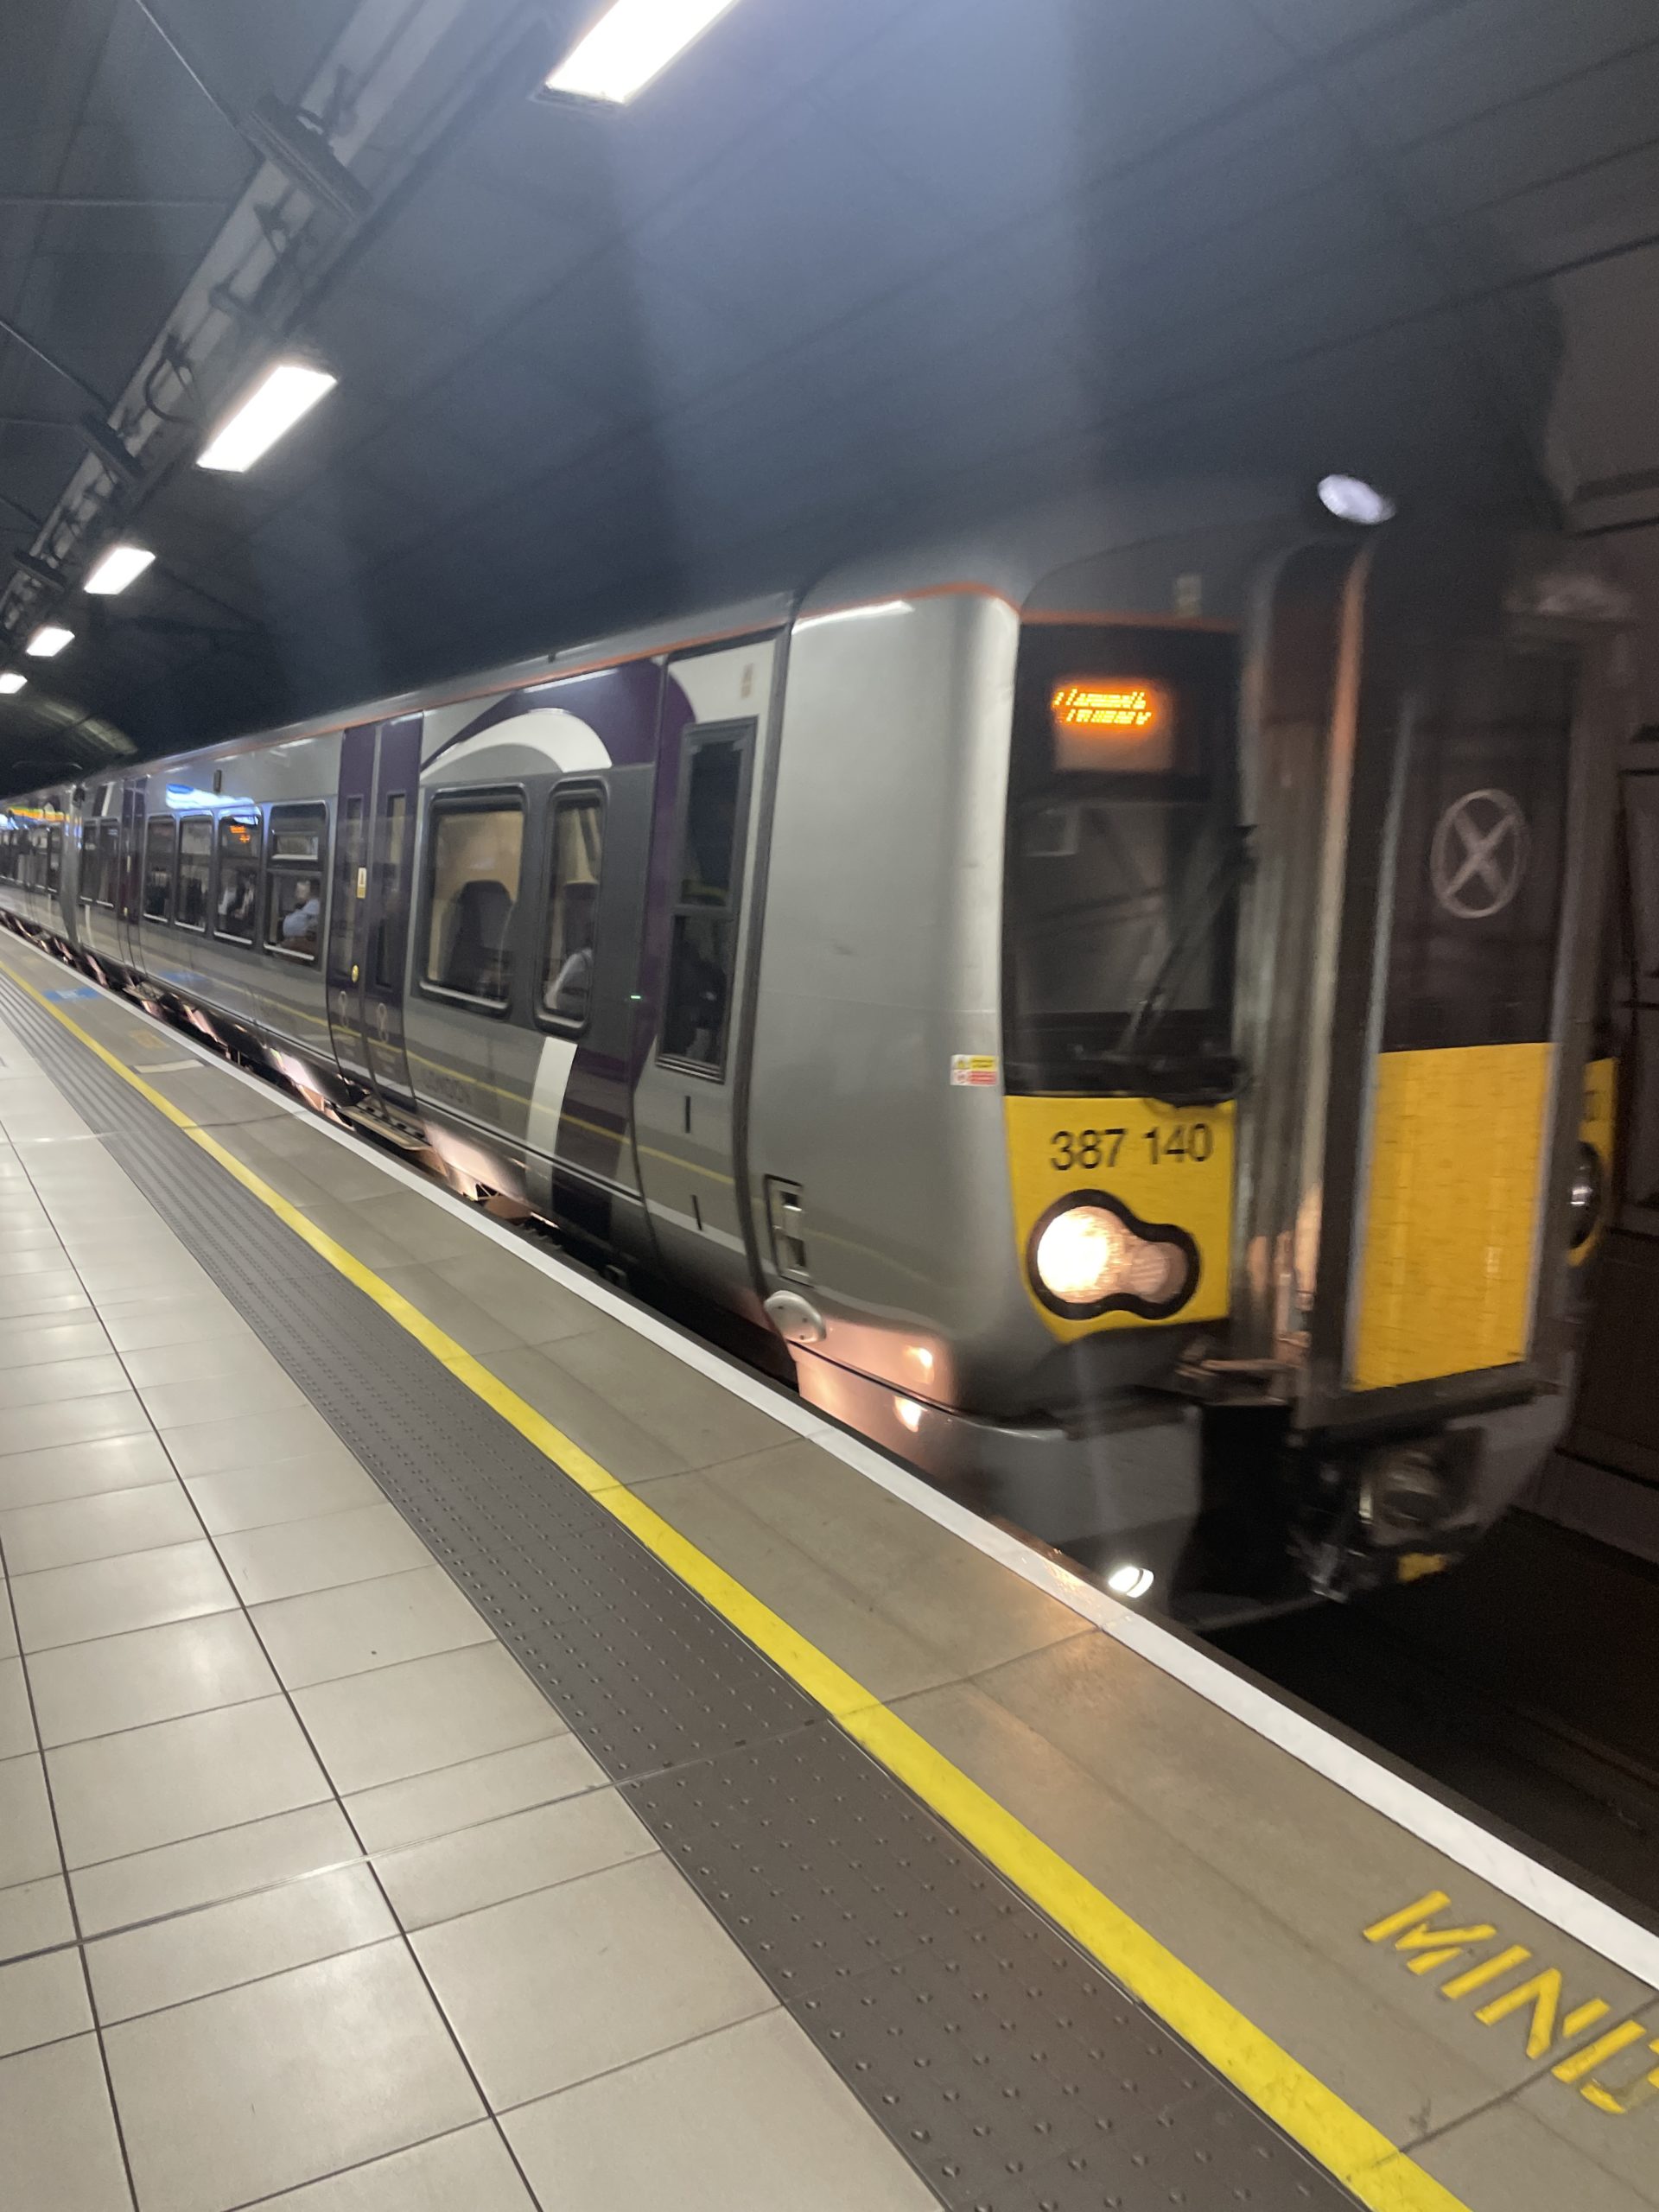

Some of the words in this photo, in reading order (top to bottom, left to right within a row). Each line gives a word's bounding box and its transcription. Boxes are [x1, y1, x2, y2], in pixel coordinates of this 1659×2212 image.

[1050, 1128, 1126, 1171] 387
[1142, 1122, 1214, 1166] 140
[1363, 1890, 1659, 2113] MIND
